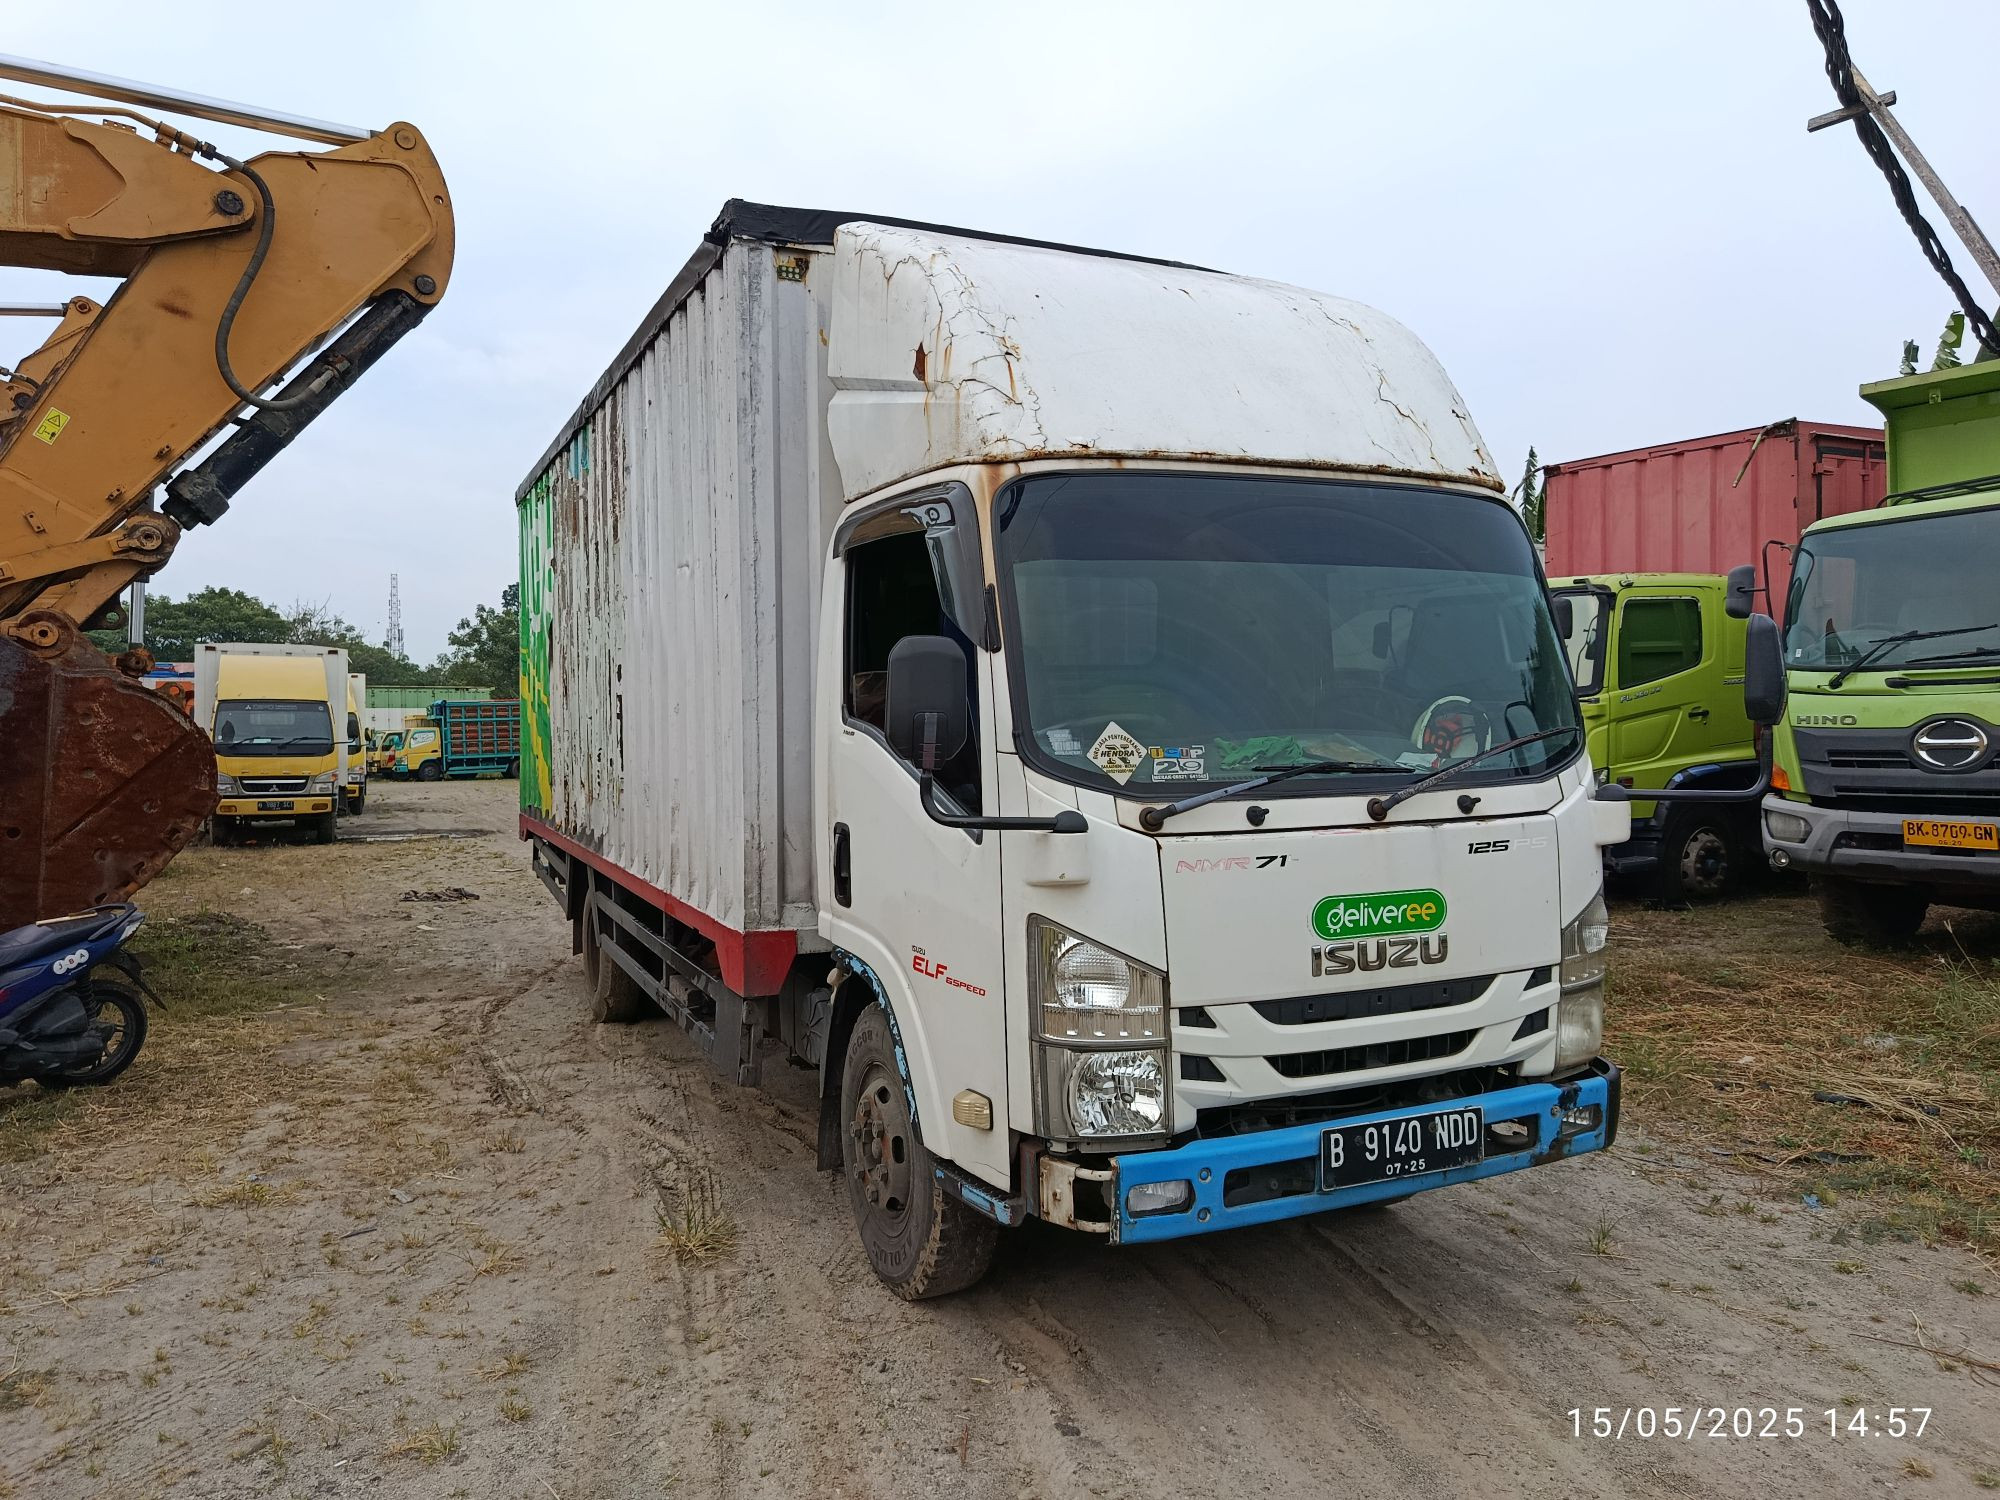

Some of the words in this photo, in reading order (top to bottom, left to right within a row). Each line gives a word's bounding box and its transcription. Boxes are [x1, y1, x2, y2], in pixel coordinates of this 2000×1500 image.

[1796, 715, 1857, 726] HINO
[1100, 750, 1135, 758] HENDRA
[1467, 840, 1510, 854] 125
[1175, 856, 1251, 873] NMR
[1326, 902, 1437, 931] deliveree
[912, 945, 926, 956] ISUZU
[1311, 932, 1448, 977] ISUZU
[913, 955, 948, 979] ELF
[945, 976, 986, 997] 6SPEED
[1330, 1133, 1345, 1169] B
[1364, 1120, 1422, 1161] 9140
[1434, 1112, 1478, 1150] NDD
